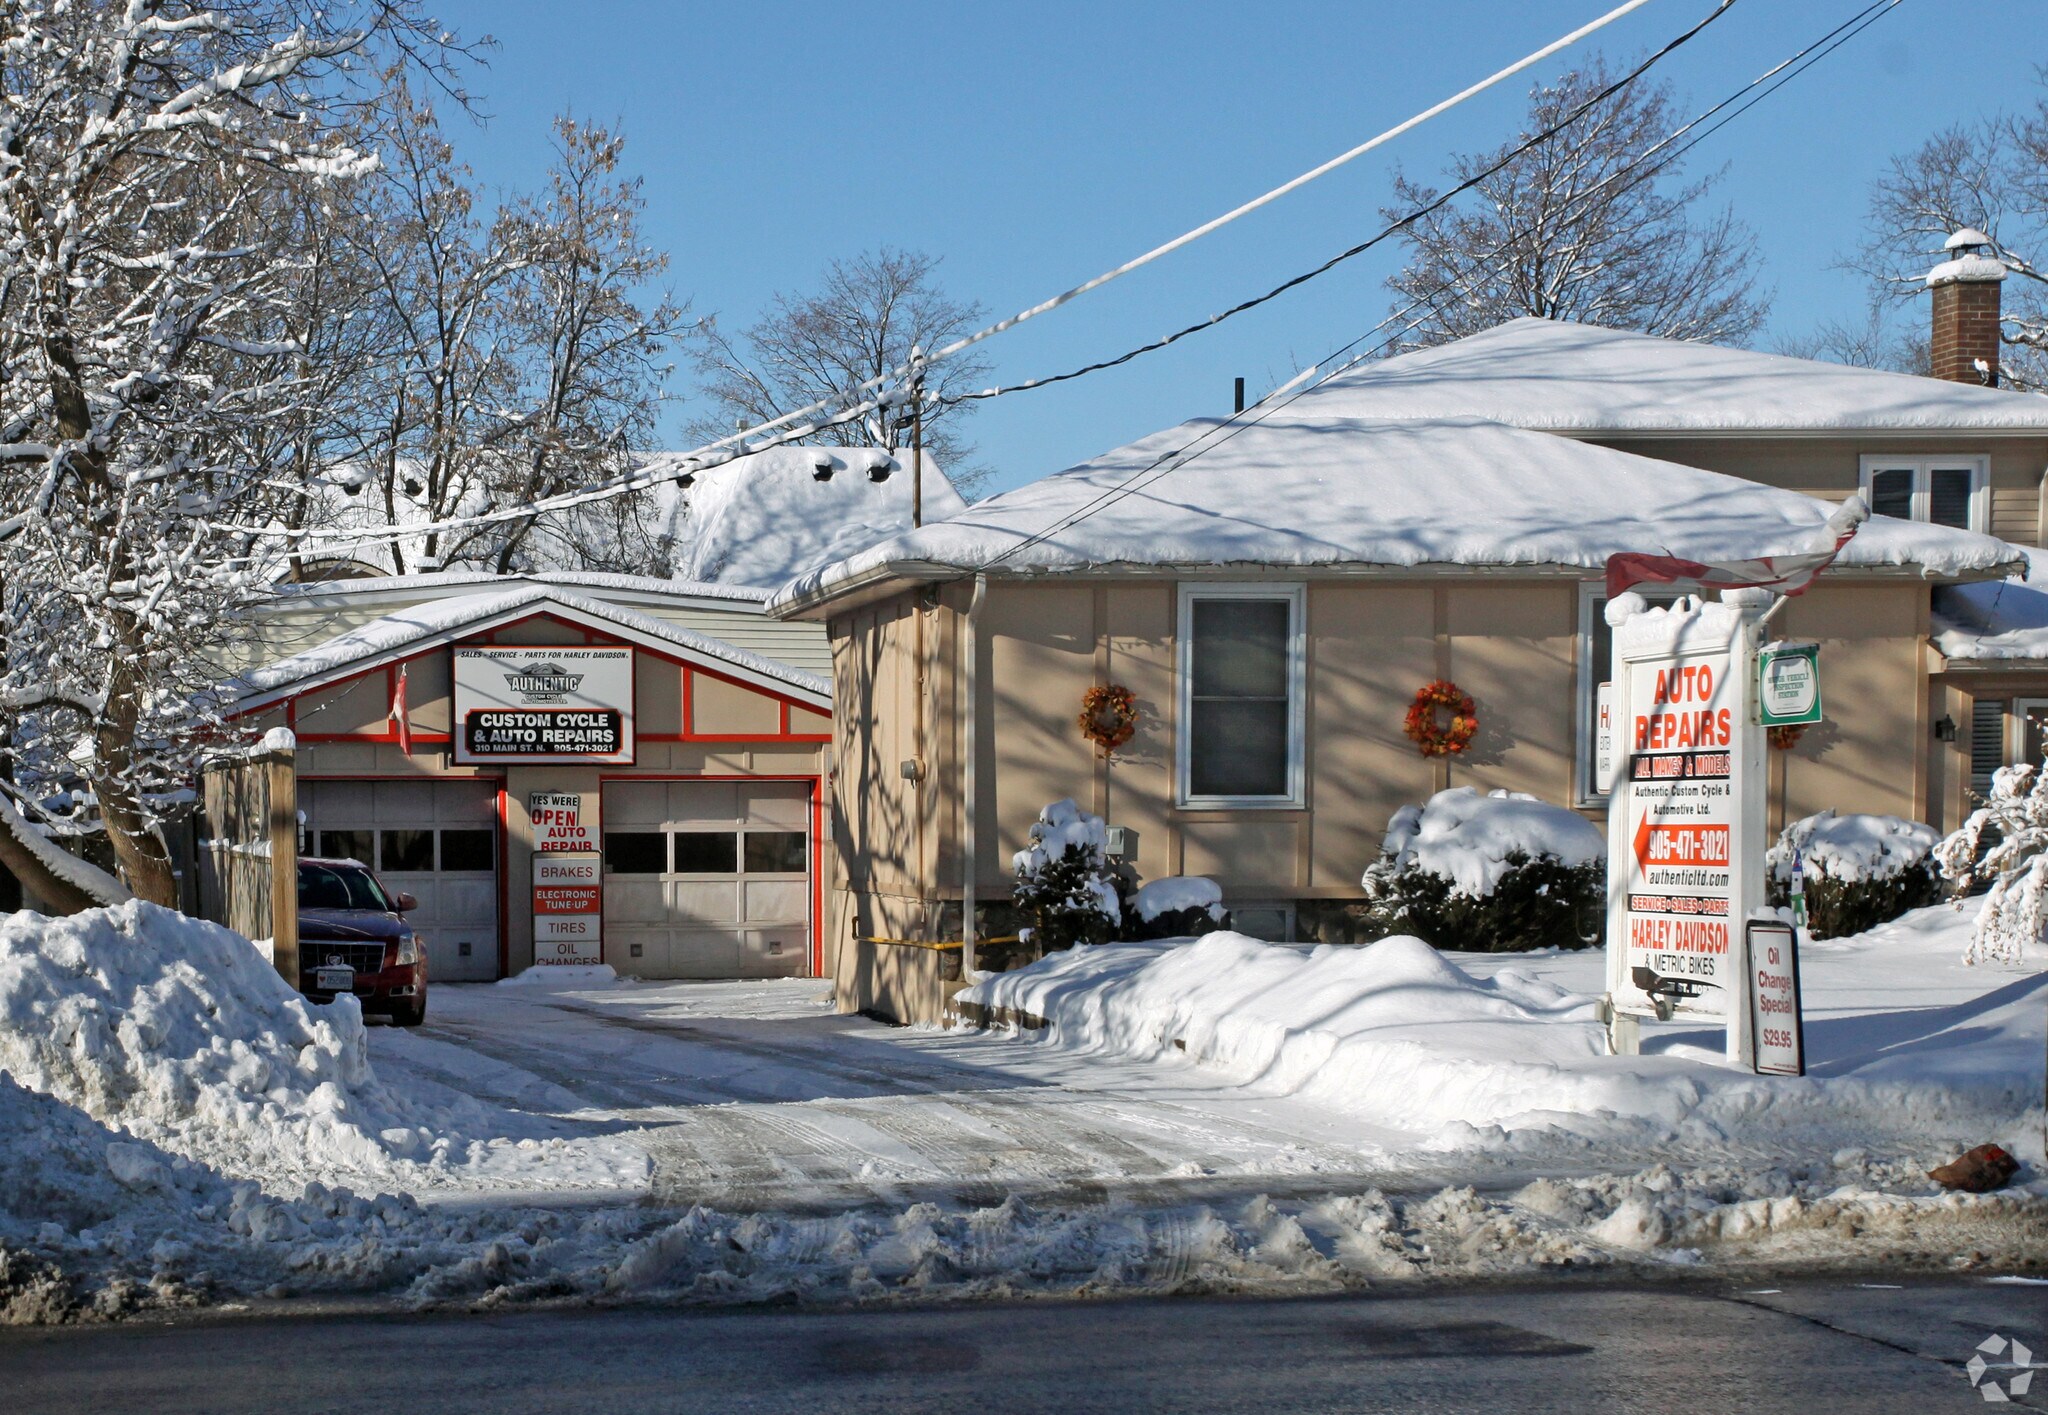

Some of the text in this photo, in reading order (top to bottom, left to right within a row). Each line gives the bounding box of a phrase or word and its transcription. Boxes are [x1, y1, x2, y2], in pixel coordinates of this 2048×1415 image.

[489, 651, 518, 659] SERVICE
[524, 651, 546, 659] PARTS
[547, 651, 562, 659] FOR
[563, 651, 591, 659] HARLEY
[511, 676, 579, 692] AUTHENTIC
[1654, 664, 1713, 705] AUTO
[480, 714, 608, 727] CUSTOM CYCLE
[473, 729, 614, 743] & AUTO REPAIRS
[1635, 708, 1731, 750] REPAIRS
[475, 744, 613, 752] 310 MAIN ST. N. 905-471-3021
[1635, 757, 1651, 778] ALL
[1652, 756, 1683, 777] MAKES
[1685, 755, 1694, 777] &
[1695, 754, 1730, 776] MODELS
[1635, 783, 1730, 798] Authentic Custom Cycle &
[531, 795, 578, 806] YES WERE
[1653, 803, 1711, 815] Automotive Ltd.
[531, 809, 576, 827] OPEN
[547, 827, 586, 838] AUTO
[541, 841, 592, 851] REPAIR
[1650, 829, 1728, 860] 905-471-3021
[541, 867, 593, 878] BRAKES
[1650, 869, 1729, 887] authenticltd.com
[536, 890, 596, 899] ELECTRONIC
[548, 922, 586, 933] TIRES
[1632, 918, 1729, 954] HARLEY DAVIDSON
[557, 944, 578, 955] OIL
[1768, 947, 1780, 965] Oil
[536, 957, 599, 966] CHANGES
[1654, 954, 1685, 973] METRIC
[1689, 956, 1715, 976] BIKES
[1759, 971, 1792, 994] Change
[1760, 996, 1792, 1015] Special
[1763, 1028, 1792, 1049] $29.95
